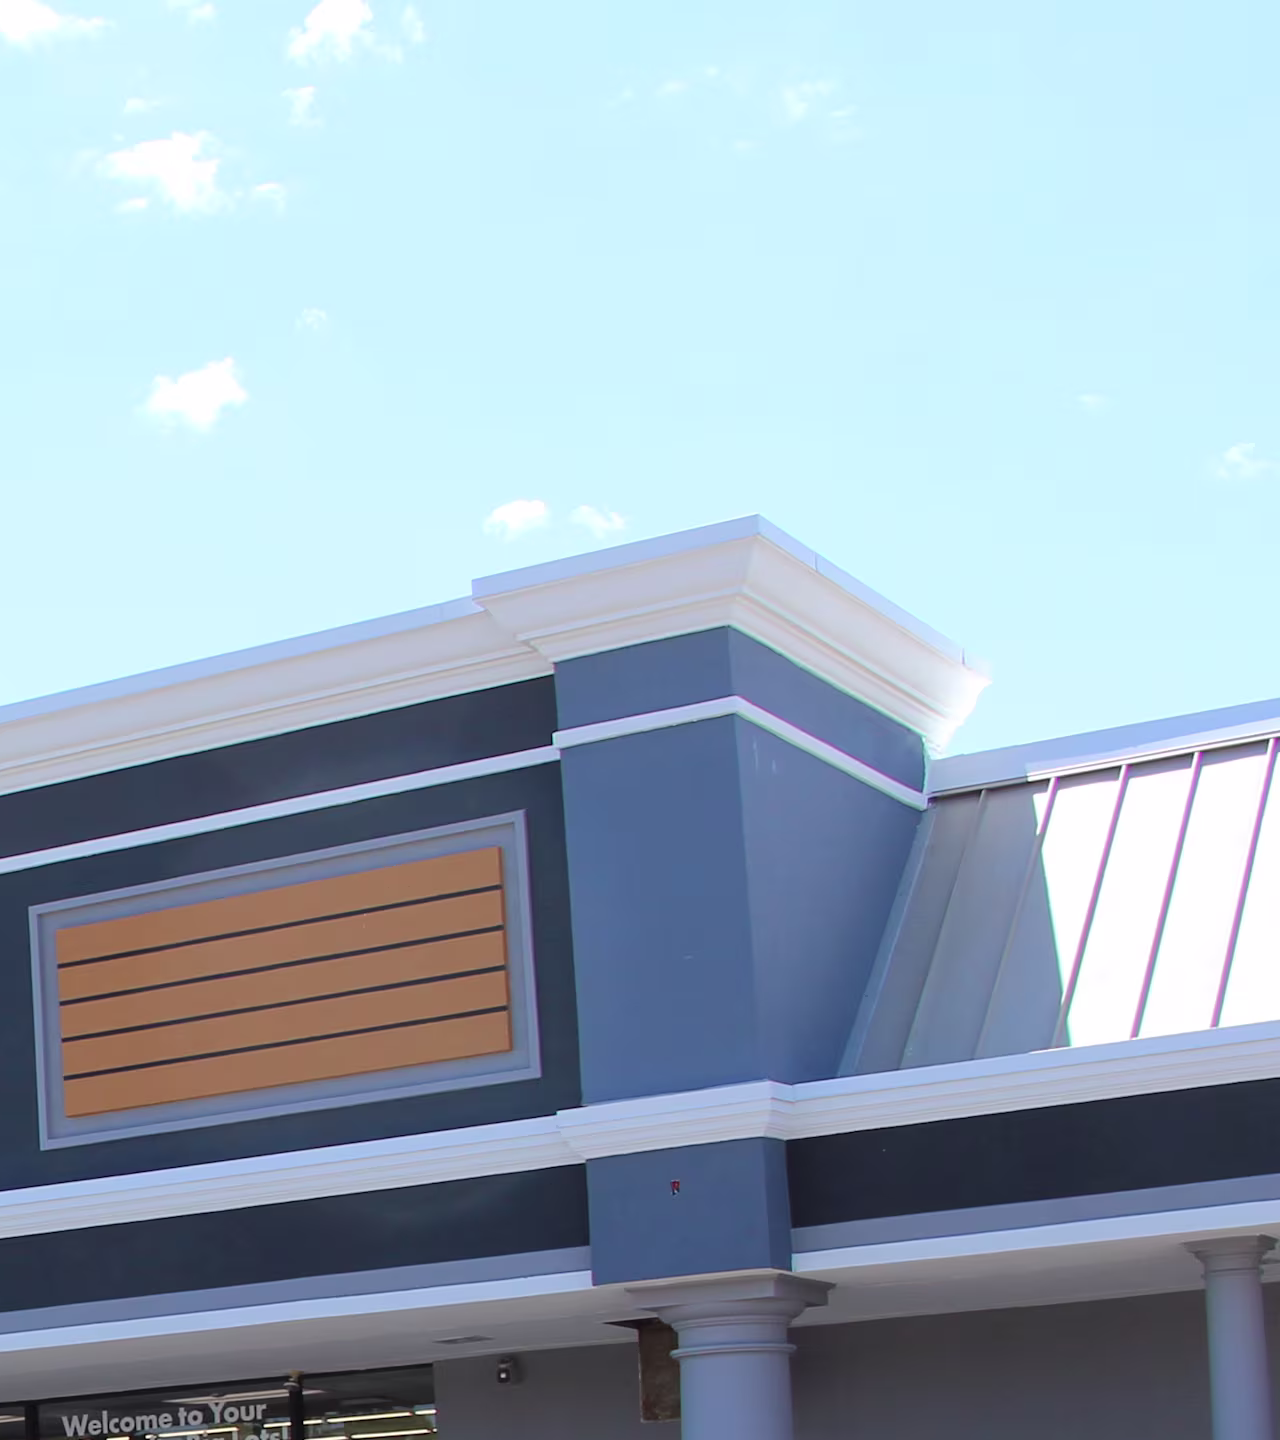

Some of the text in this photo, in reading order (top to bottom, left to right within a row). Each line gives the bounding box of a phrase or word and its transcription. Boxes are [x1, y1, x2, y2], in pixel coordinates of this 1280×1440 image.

[62, 1401, 267, 1437] Welcome to Your
